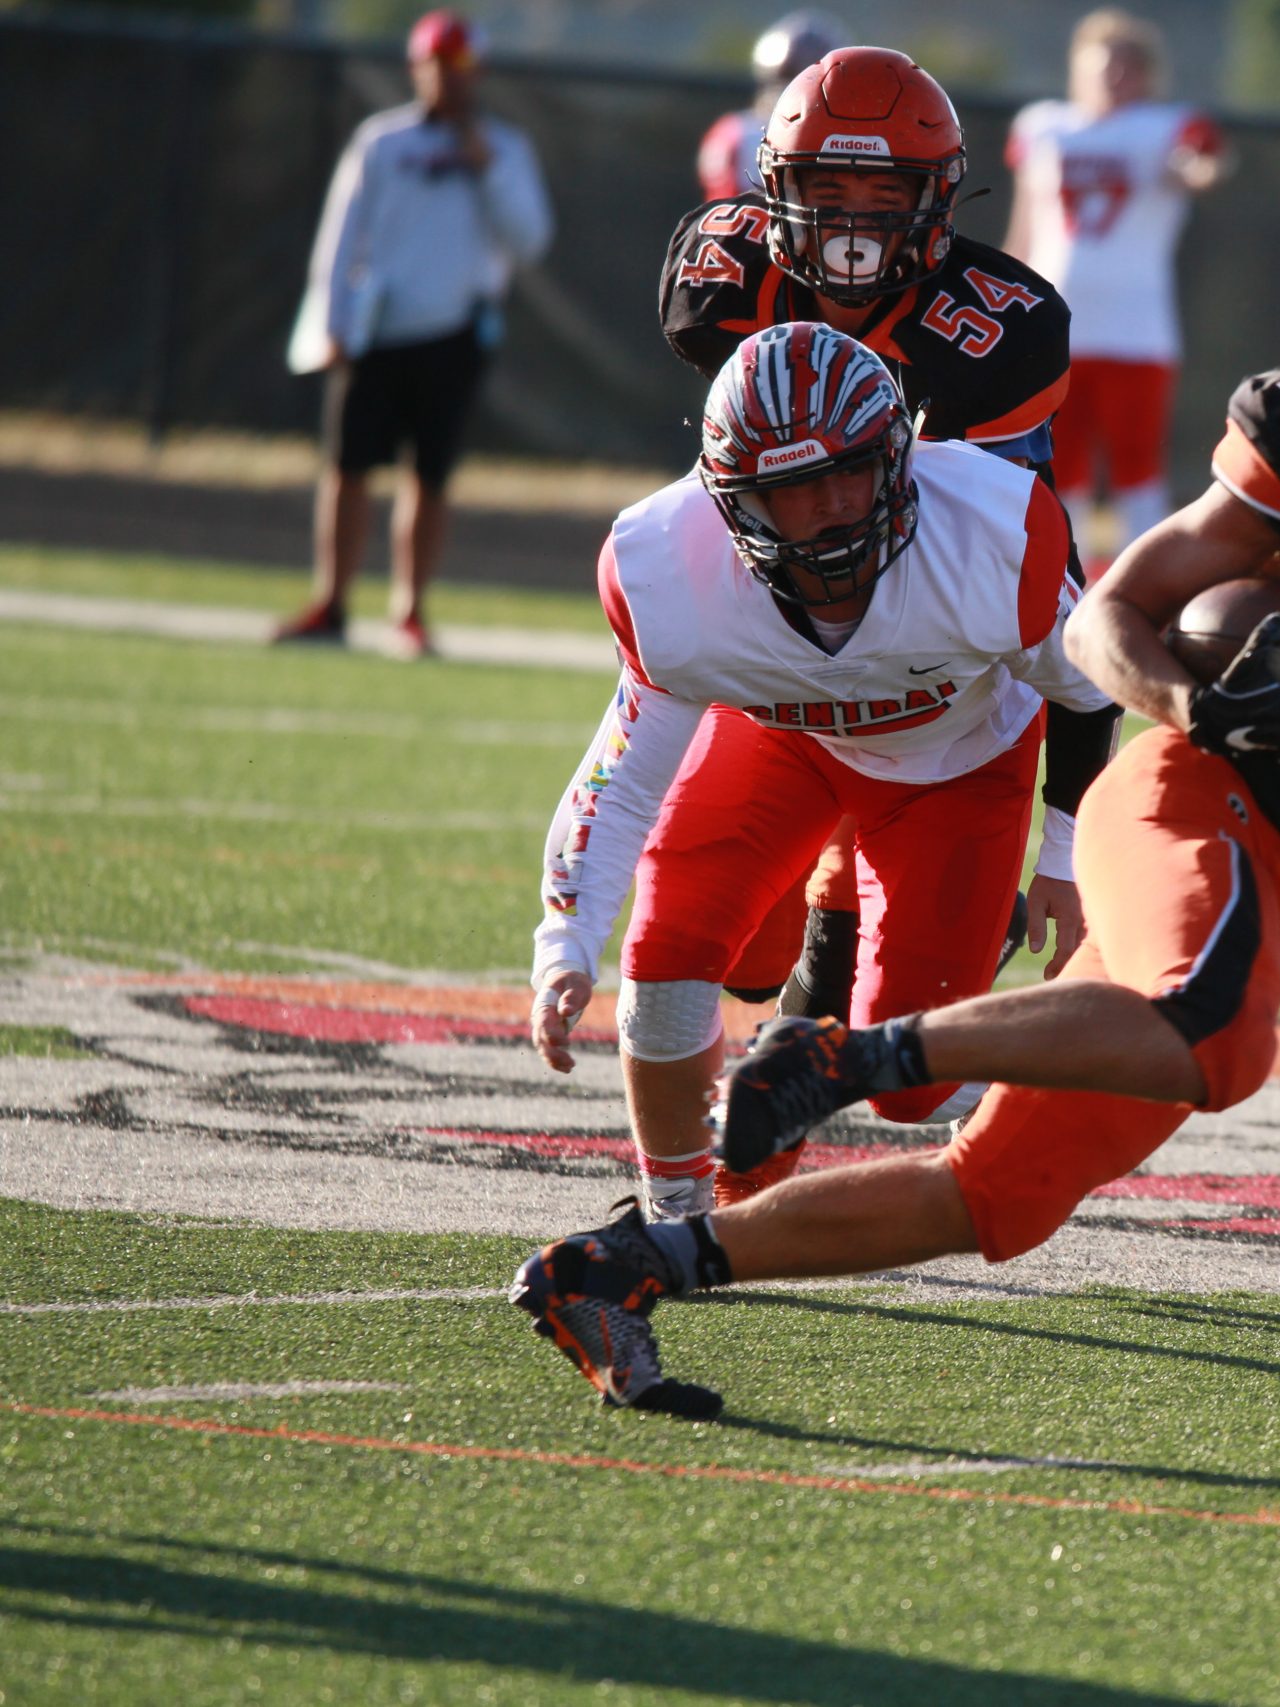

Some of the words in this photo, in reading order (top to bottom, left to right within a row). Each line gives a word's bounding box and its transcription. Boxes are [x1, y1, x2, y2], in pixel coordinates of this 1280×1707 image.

[676, 203, 772, 289] 54
[920, 266, 1045, 358] 54
[763, 443, 816, 467] Riddell
